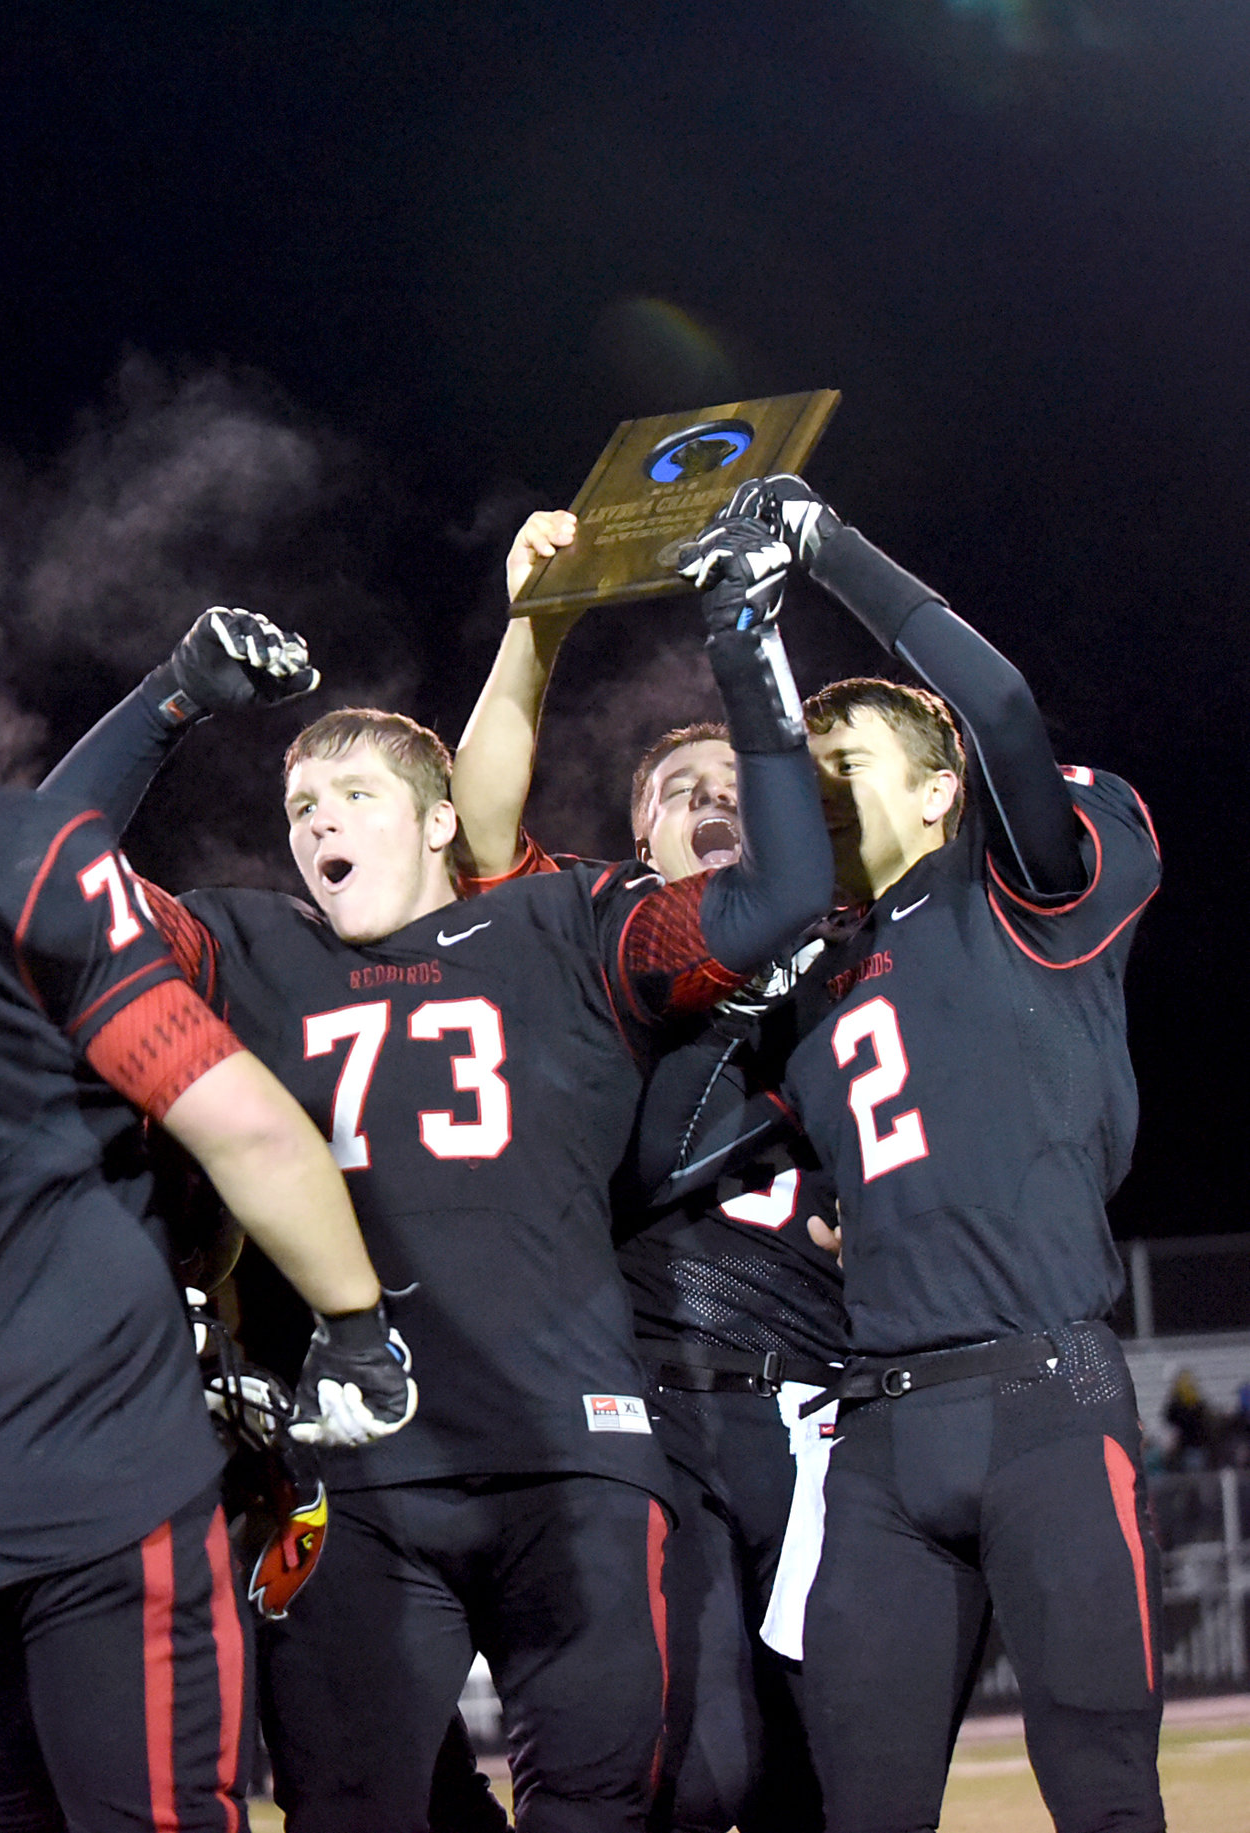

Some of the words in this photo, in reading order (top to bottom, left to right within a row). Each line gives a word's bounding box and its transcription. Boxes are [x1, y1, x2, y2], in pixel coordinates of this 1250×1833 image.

[349, 958, 443, 990] REDBIRDS
[302, 995, 512, 1171] 73
[831, 994, 930, 1184] 2
[623, 1401, 639, 1415] XL
